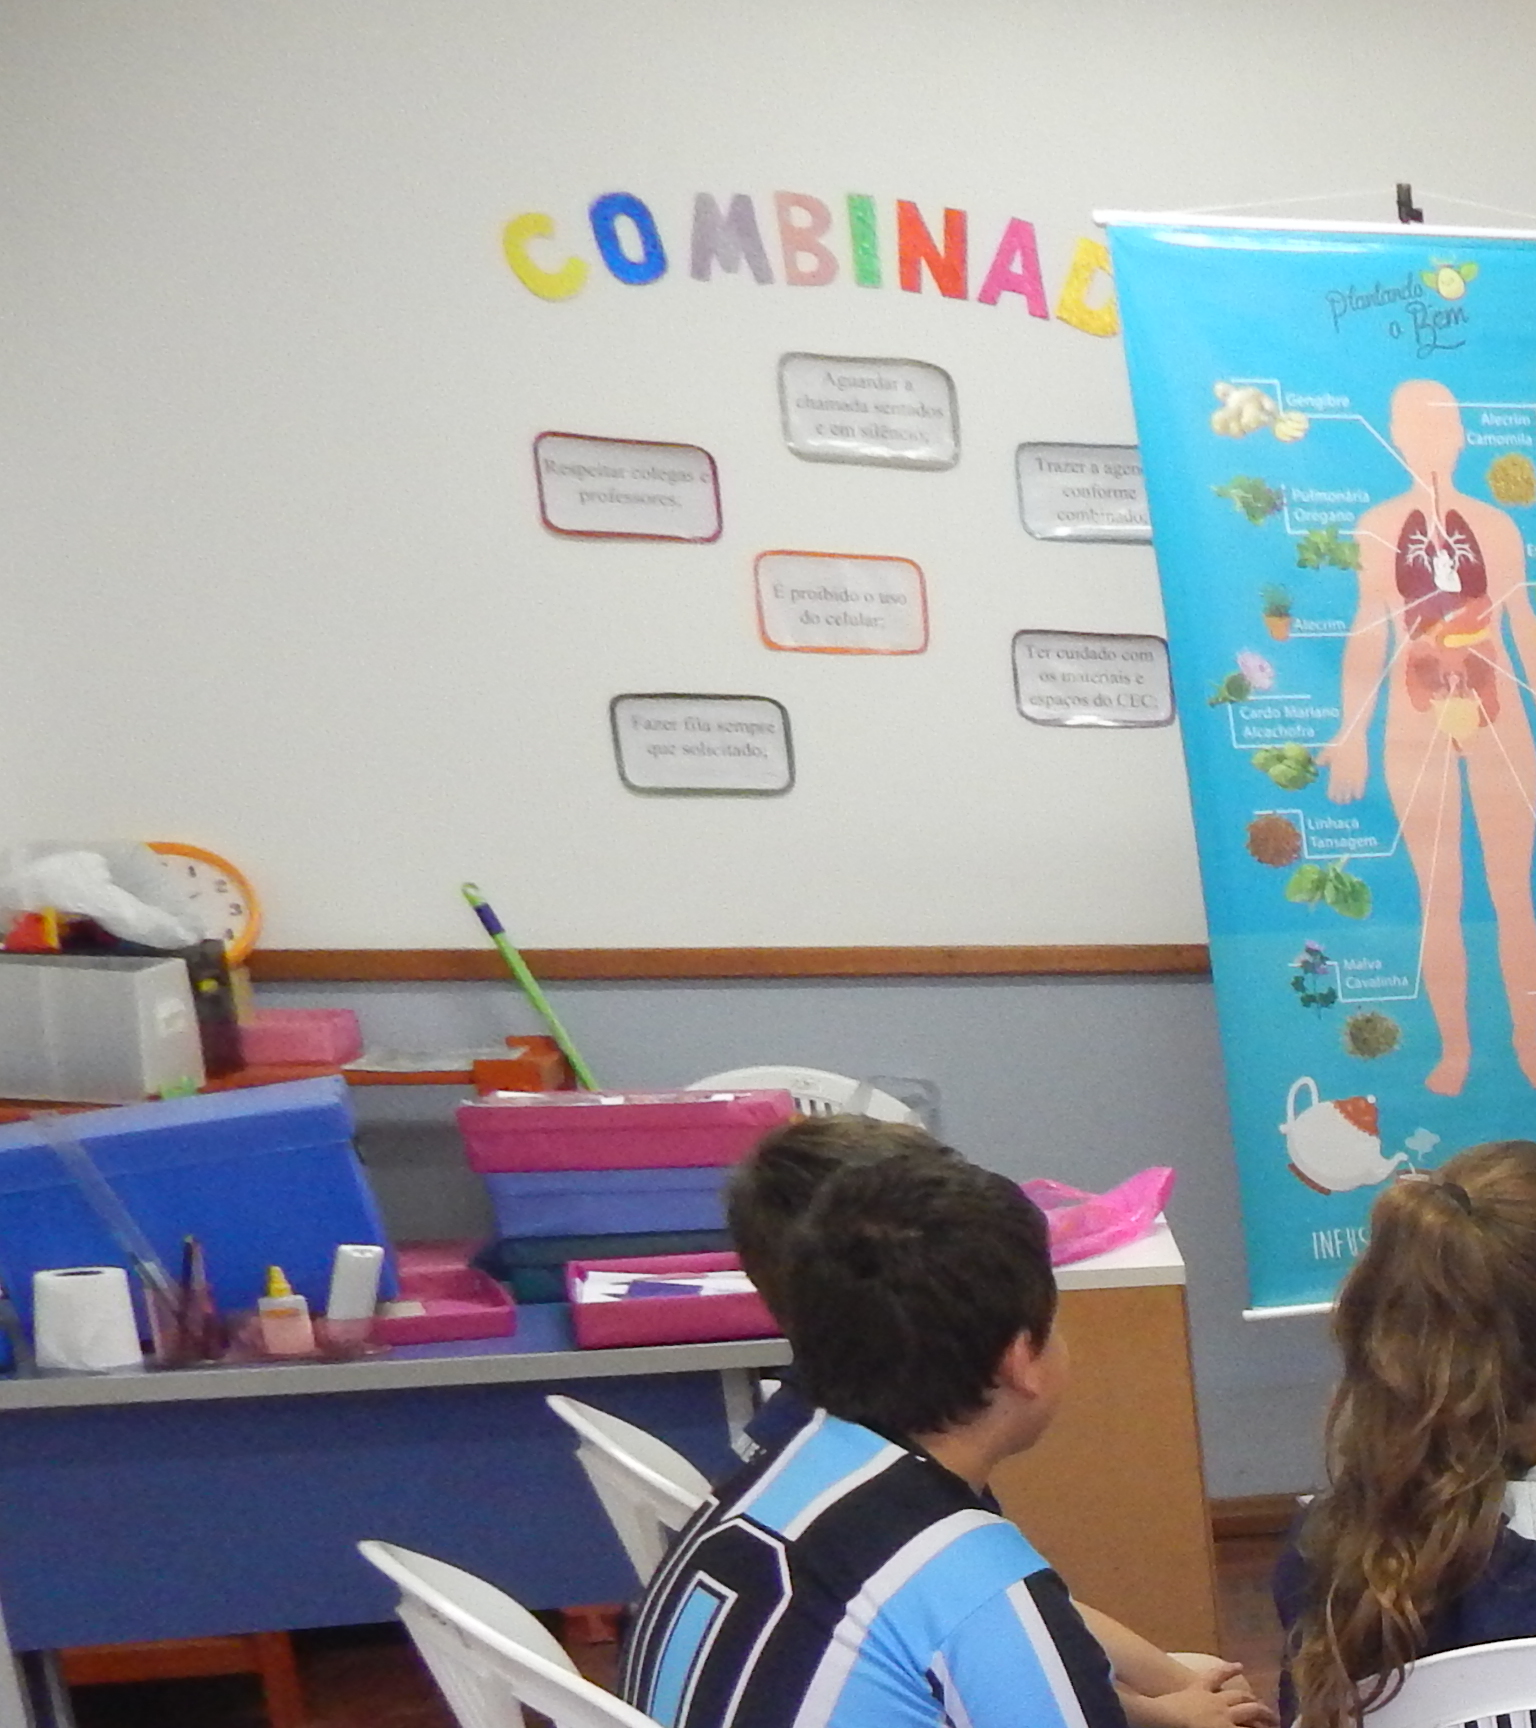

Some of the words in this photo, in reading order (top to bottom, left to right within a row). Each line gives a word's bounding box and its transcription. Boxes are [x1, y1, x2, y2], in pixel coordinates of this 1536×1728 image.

[1325, 271, 1423, 334] Plantando
[1405, 300, 1469, 359] Bem
[822, 371, 899, 391] Aguardar
[796, 395, 869, 413] chamada
[1285, 393, 1351, 411] Gengibre
[1481, 413, 1531, 426] Alecrim
[1466, 432, 1533, 447] Camomila
[1035, 457, 1086, 473] Trazer
[1090, 463, 1100, 474] a
[1062, 484, 1137, 500] conforme
[1291, 487, 1370, 503] Pulmonária
[790, 586, 862, 604] proibido
[879, 592, 907, 606] uso
[799, 610, 821, 625] do
[1294, 618, 1346, 631] Alecrim
[1026, 644, 1050, 659] Ter
[1056, 646, 1117, 661] cuidado
[1121, 650, 1155, 662] com
[1239, 705, 1281, 720] Cardo
[1284, 705, 1340, 719] Mariano
[630, 715, 677, 731] Fazer
[684, 716, 711, 732] fila
[717, 721, 777, 736] sempre
[1243, 724, 1315, 739] Alcachofra
[647, 744, 676, 760] que
[1311, 835, 1378, 850] Tansagem
[1343, 958, 1382, 971] Malva
[1346, 975, 1409, 990] Cavalinha
